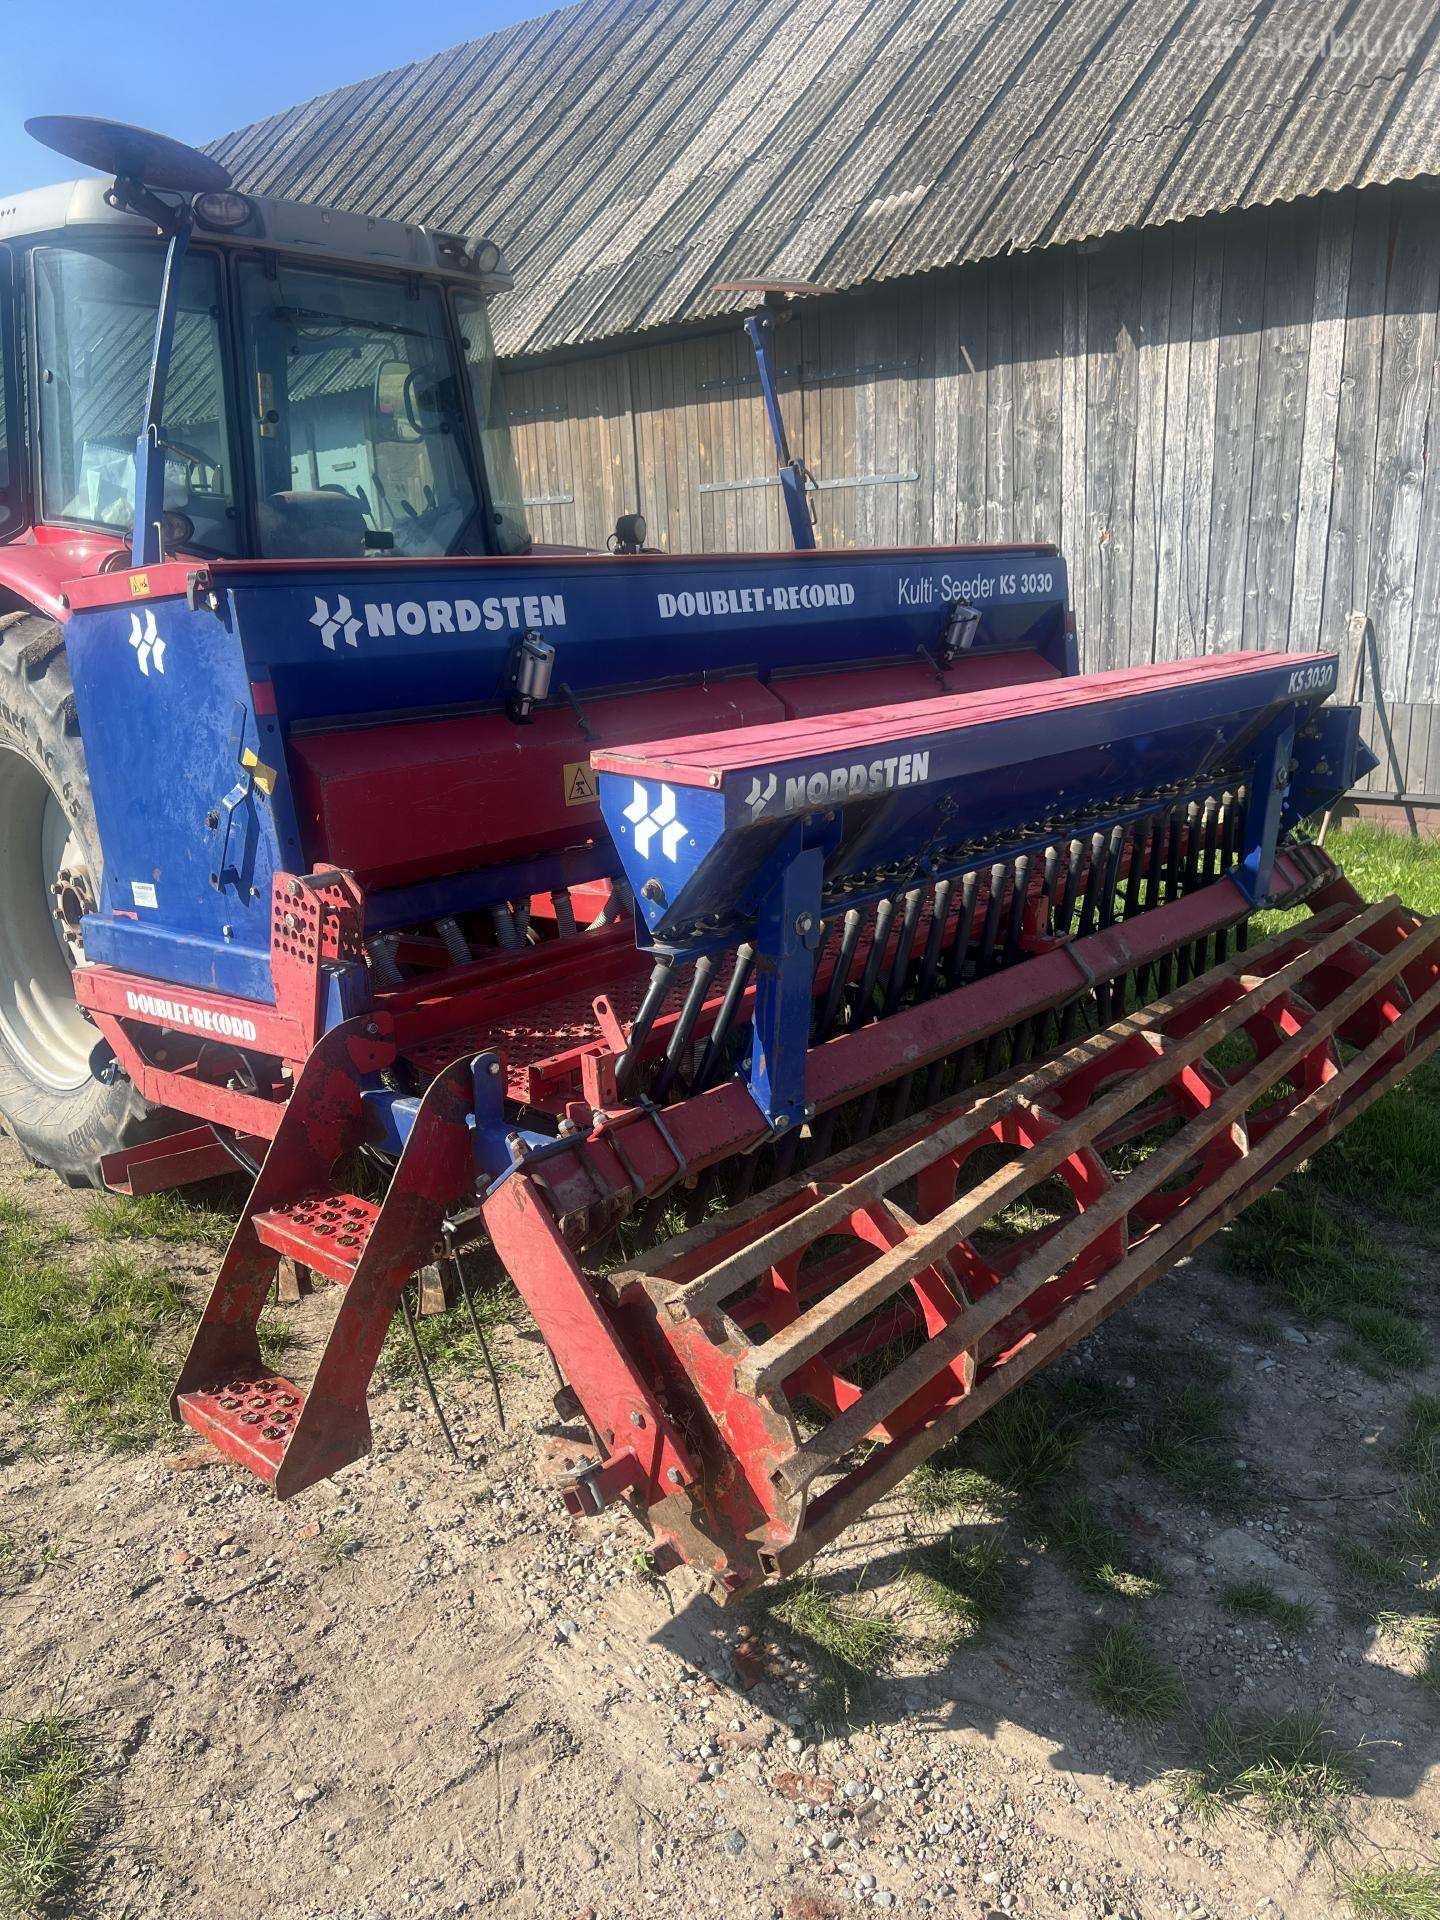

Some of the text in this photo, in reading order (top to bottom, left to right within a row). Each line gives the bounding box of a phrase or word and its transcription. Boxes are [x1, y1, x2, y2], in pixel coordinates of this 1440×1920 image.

[1000, 574, 1016, 595] KS
[1020, 573, 1053, 594] 3030
[364, 595, 566, 637] NORDSTEN
[1287, 664, 1333, 694] KS 3030
[784, 751, 930, 811] NORDSTEN
